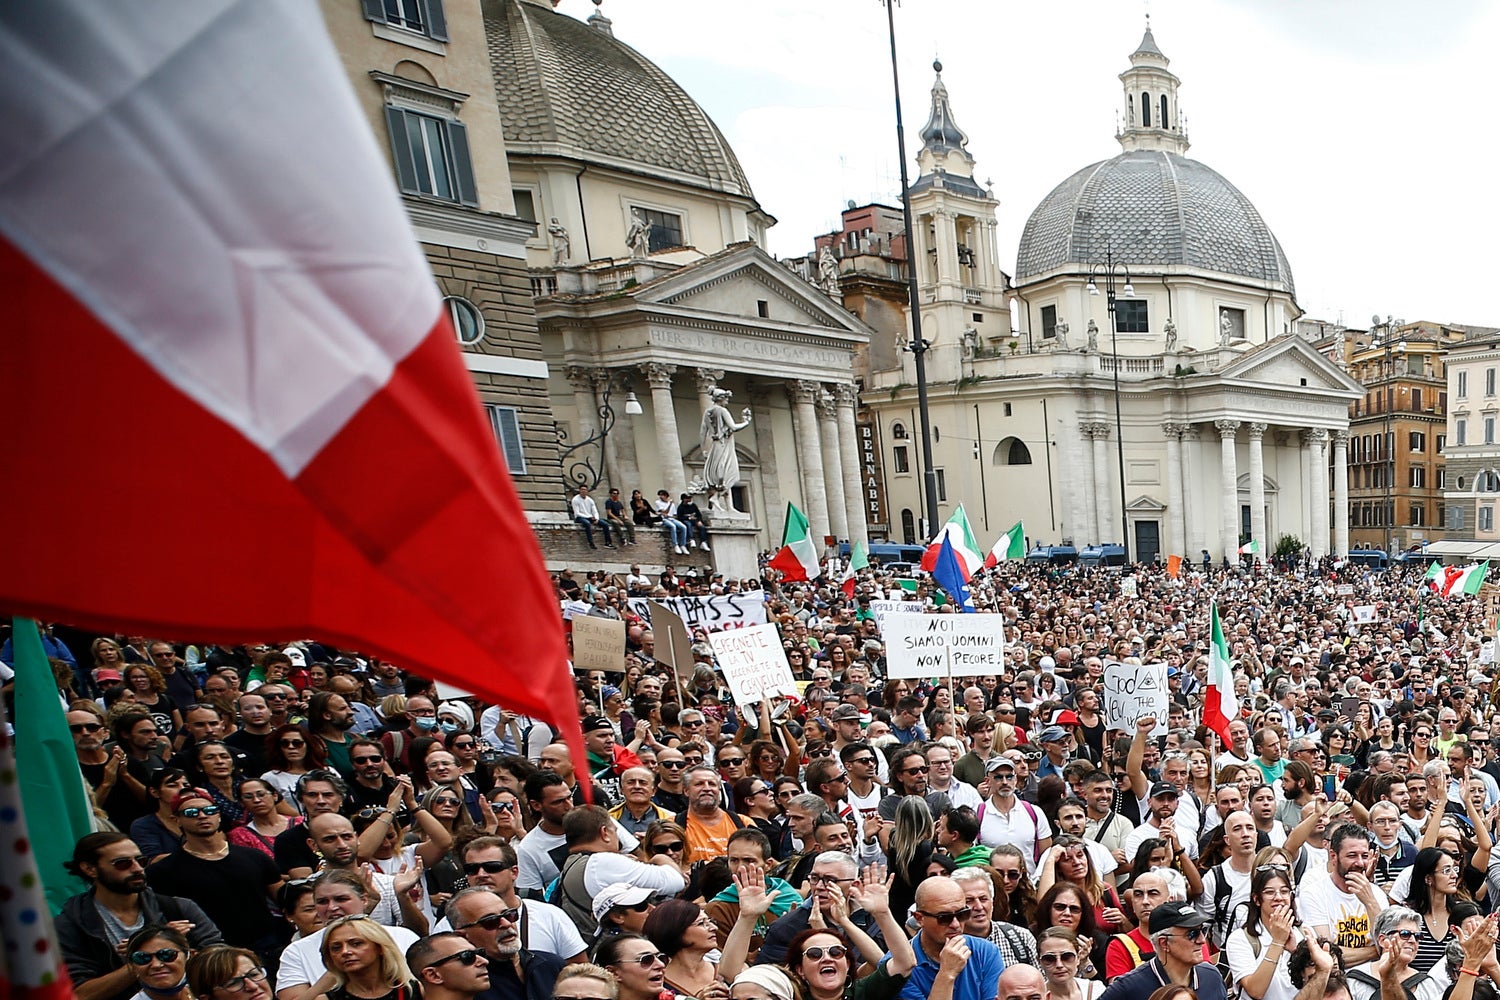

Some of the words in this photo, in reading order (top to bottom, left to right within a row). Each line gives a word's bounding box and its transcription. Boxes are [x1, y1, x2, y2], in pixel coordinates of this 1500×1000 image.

[861, 426, 879, 524] BERNABEI
[681, 593, 746, 622] PASS
[927, 618, 954, 632] NOI
[714, 631, 768, 655] SPEGNETE
[904, 635, 944, 649] SIAMO
[952, 635, 993, 647] UOMINI
[740, 650, 755, 664] TV
[916, 655, 943, 667] NON
[953, 648, 1001, 665] PECORE!
[741, 670, 790, 696] CERVELLO!
